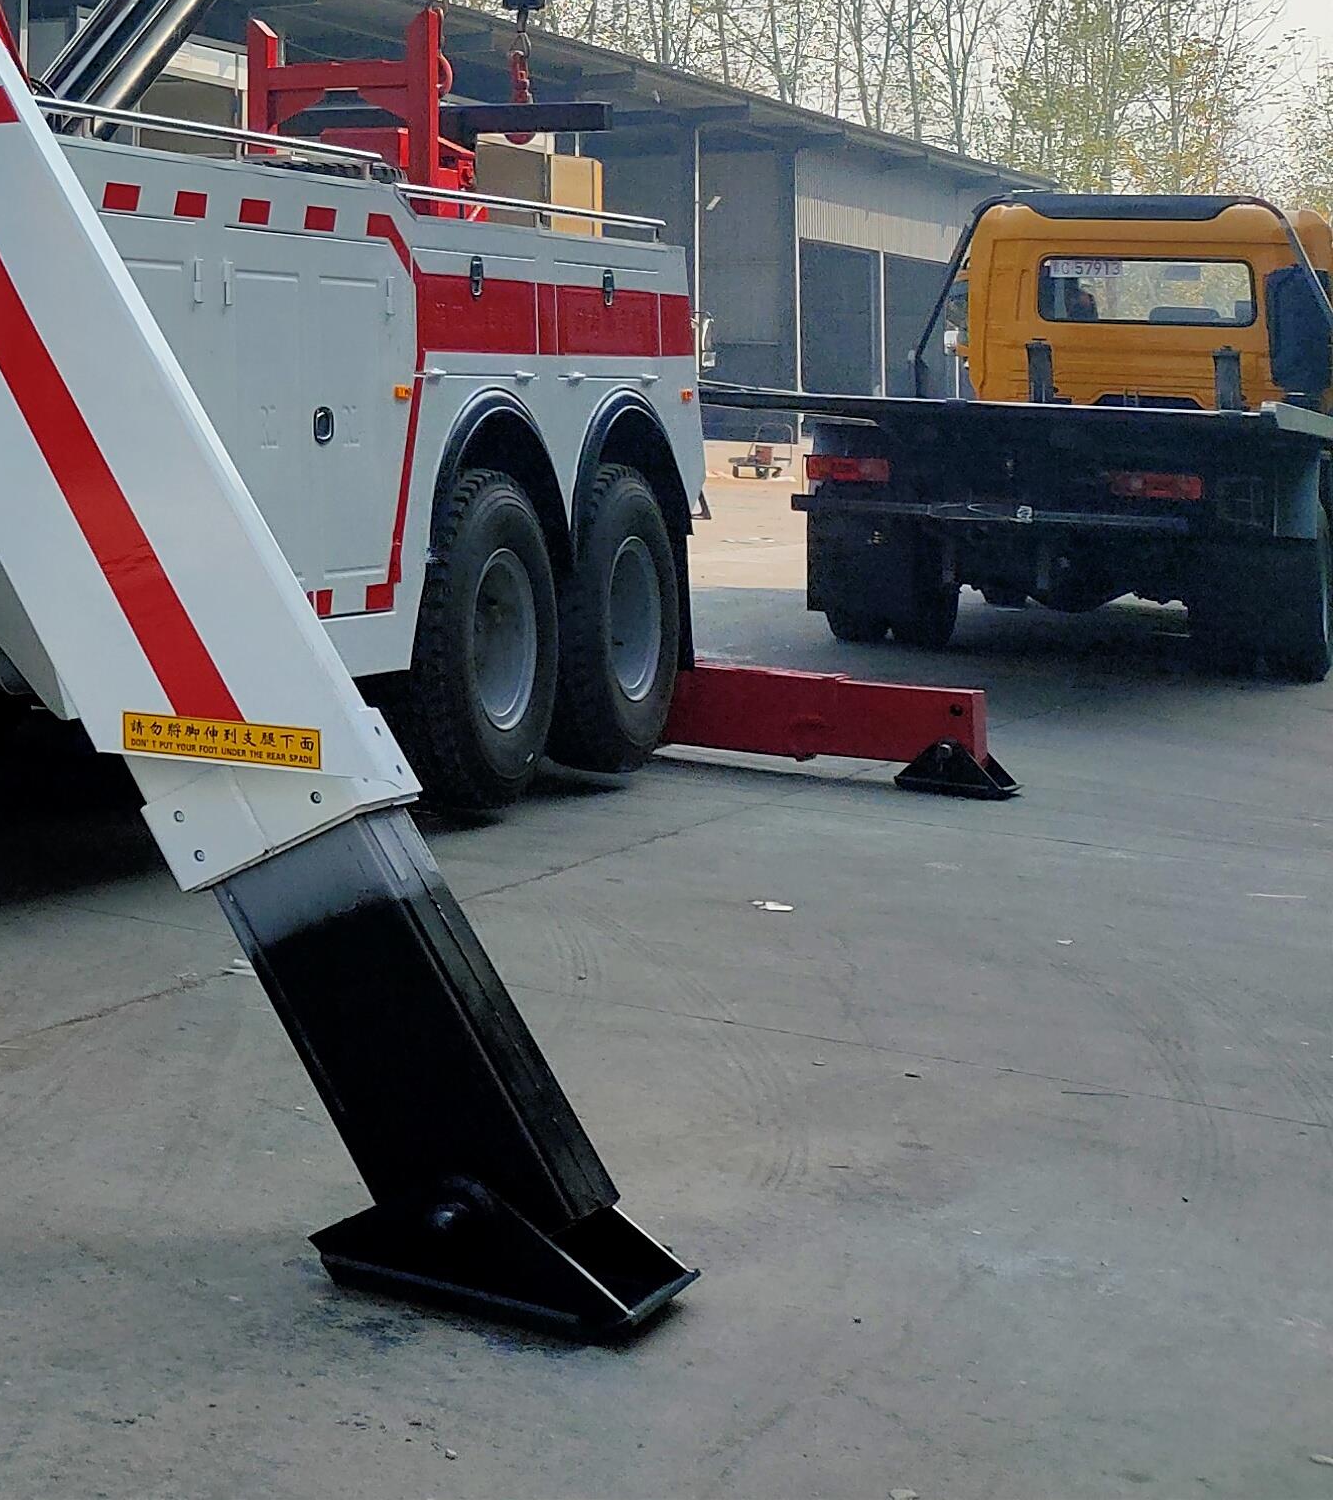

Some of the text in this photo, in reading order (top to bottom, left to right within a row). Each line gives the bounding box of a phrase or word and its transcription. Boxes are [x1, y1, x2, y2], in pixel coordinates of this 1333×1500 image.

[159, 741, 173, 749] PUT
[177, 743, 197, 752] YOUR
[199, 745, 218, 754] FOOT
[221, 748, 247, 757] UNDER
[250, 750, 263, 759] THE
[267, 752, 286, 761] REAR
[289, 754, 313, 764] SPADE
